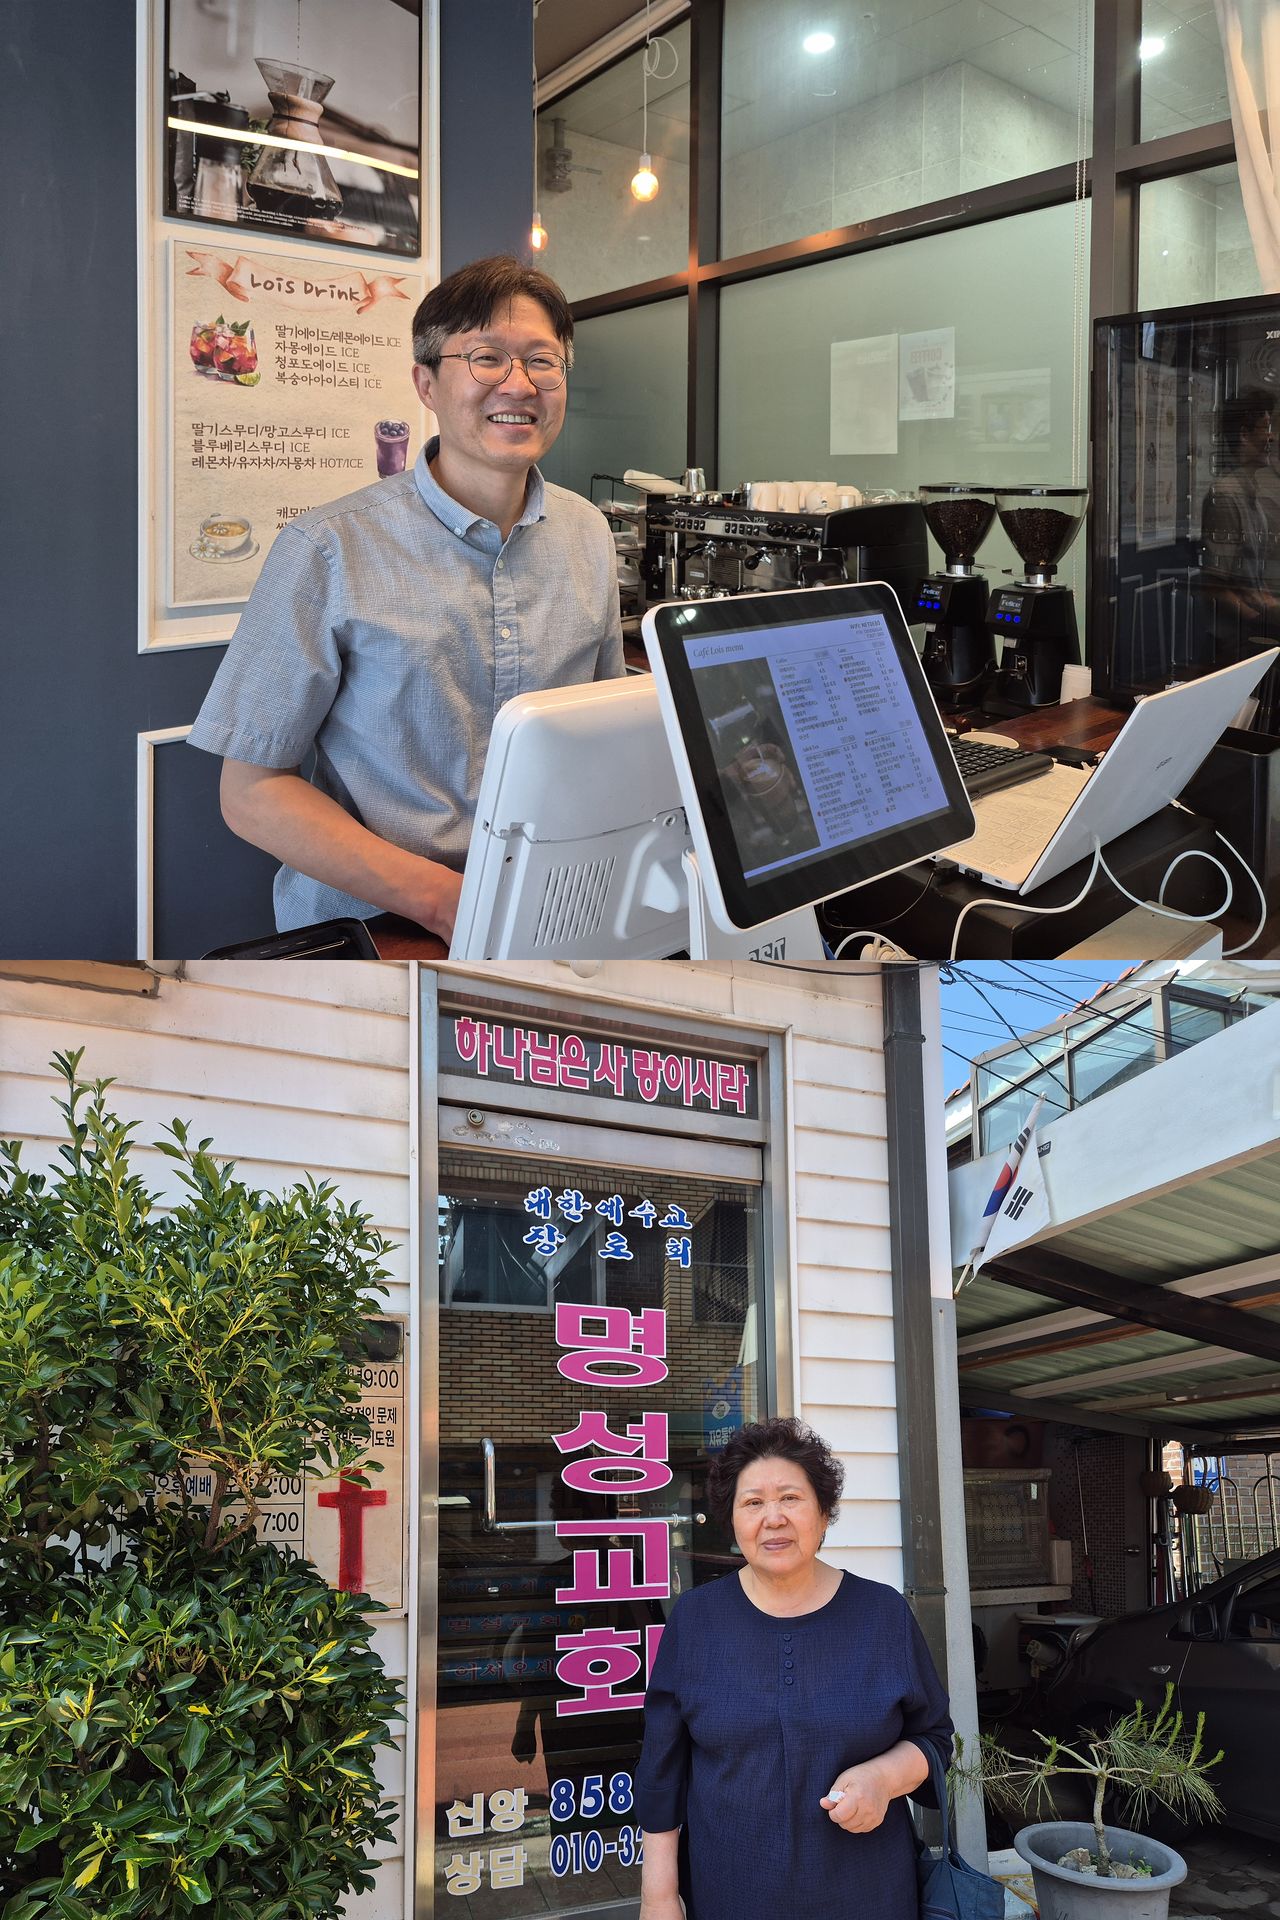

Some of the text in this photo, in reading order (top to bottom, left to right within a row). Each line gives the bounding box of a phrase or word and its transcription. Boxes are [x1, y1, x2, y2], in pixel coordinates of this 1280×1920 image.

[251, 273, 360, 301] Lois Drink
[275, 324, 402, 347] 딸기에이드/레몬에이드 ICE
[275, 341, 360, 358] 자몽에이드 ICE
[275, 355, 371, 374] 청포도에이드 ICE
[275, 372, 382, 389] 복숭아아이스티 ICE
[191, 422, 350, 440] 딸기스무디/망고스무디 ICE
[191, 439, 310, 454] 블루베리스무디 ICE
[191, 455, 364, 471] 레몬차/유자차/자몽차 HOT/ICE
[454, 1016, 590, 1091] 하나님은
[523, 1185, 693, 1230] 대한예수교
[364, 1369, 399, 1389] 9:00
[377, 1407, 397, 1425] 문제
[551, 1302, 673, 1717] 명성교회
[262, 1512, 299, 1533] 7:00
[445, 1771, 634, 1839] 신앙 858
[443, 1844, 528, 1896] 상담
